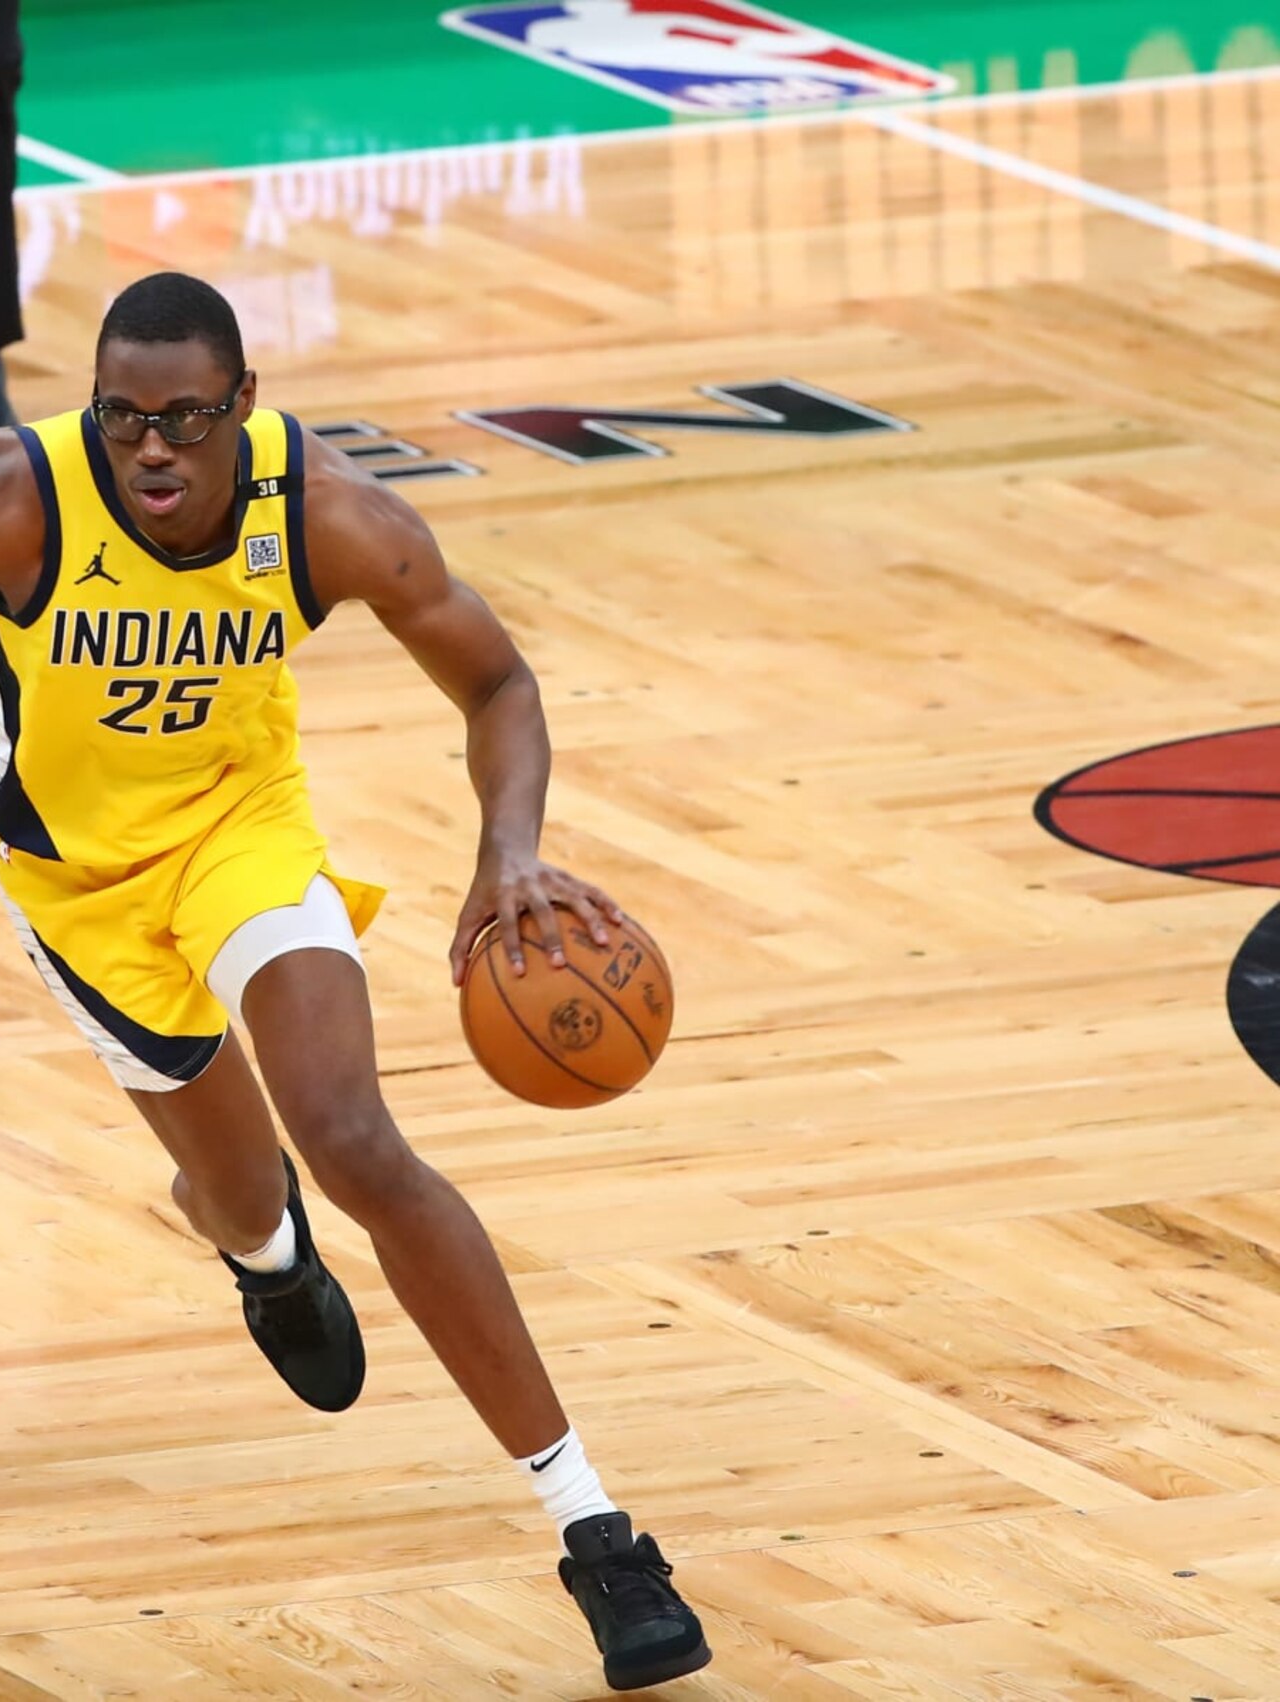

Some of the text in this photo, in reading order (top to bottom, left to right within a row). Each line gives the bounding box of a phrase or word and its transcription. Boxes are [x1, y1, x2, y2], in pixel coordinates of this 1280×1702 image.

[258, 479, 279, 497] 30
[50, 608, 286, 668] INDIANA
[96, 676, 221, 735] 25
